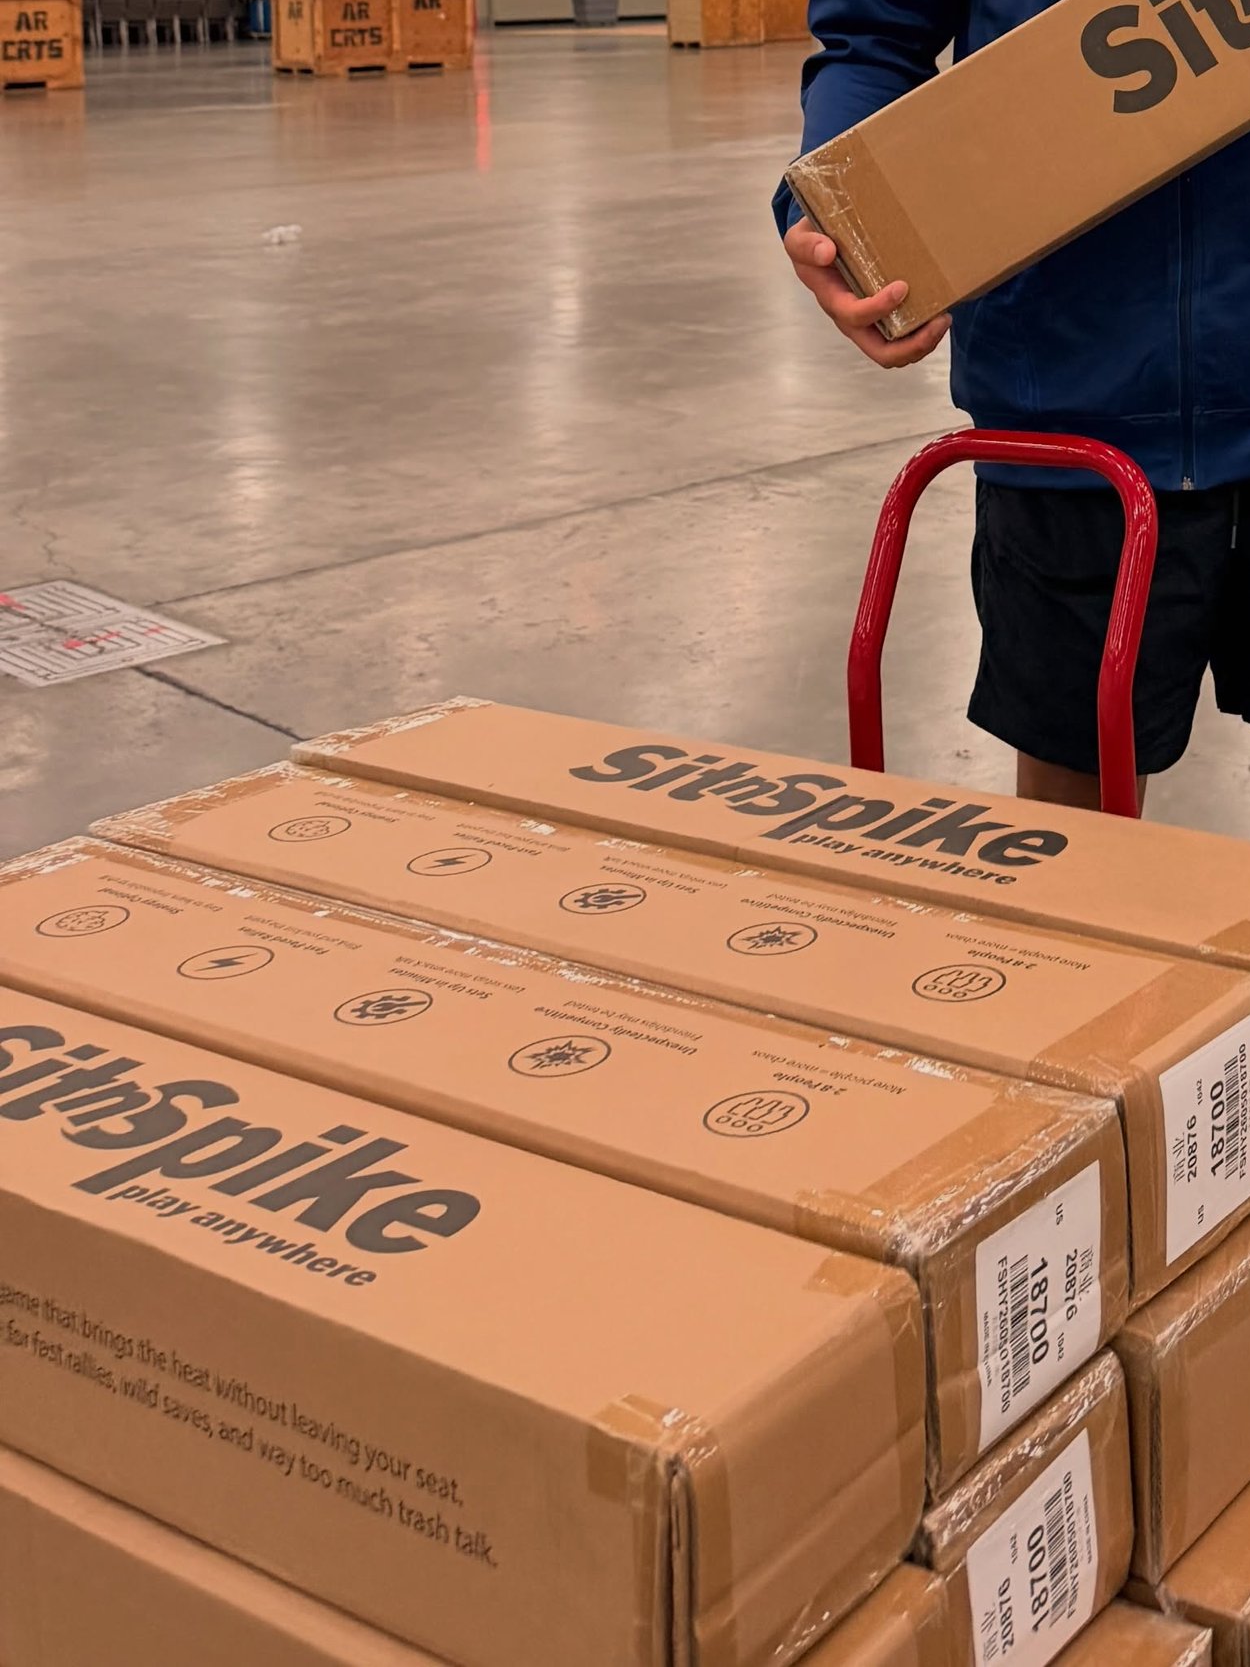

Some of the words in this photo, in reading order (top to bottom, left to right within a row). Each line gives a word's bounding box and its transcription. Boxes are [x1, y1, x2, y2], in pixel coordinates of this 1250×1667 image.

[343, 1, 370, 21] AR
[16, 11, 48, 31] AR
[330, 27, 383, 47] CRTS
[2, 39, 63, 61] CRTS
[568, 745, 1068, 867] SitnSpike
[787, 831, 861, 858] play
[862, 845, 1018, 886] anywhere
[602, 865, 643, 880] Minutes
[655, 879, 675, 887] Up
[675, 884, 700, 894] Sets
[766, 893, 801, 904] tested
[799, 899, 813, 908] be
[815, 903, 838, 912] may
[740, 898, 812, 918] Competitive
[812, 913, 896, 939] Unexpectedly
[838, 909, 897, 927] Friendships
[946, 933, 977, 943] chaos
[977, 940, 1009, 949] more
[968, 949, 1014, 963] People
[1018, 949, 1060, 962] people
[1059, 959, 1090, 970] More
[389, 968, 434, 984] Minutes
[446, 968, 471, 978] more
[448, 982, 468, 992] Up
[467, 988, 493, 999] Sets
[505, 984, 526, 993] Less
[565, 1000, 600, 1013] tested
[598, 1009, 615, 1018] be
[534, 1006, 609, 1031] Competitive
[617, 1012, 642, 1023] may
[641, 1019, 702, 1041] Friendships
[613, 1025, 697, 1055] Unexpectedly
[753, 1051, 786, 1062] chaos
[786, 1060, 822, 1072] more
[773, 1073, 823, 1091] People
[829, 1070, 876, 1085] people
[877, 1082, 906, 1095] More
[1210, 1080, 1225, 1176] 18700
[1187, 1115, 1197, 1182] 20876
[1055, 1203, 1063, 1225] US
[1197, 1205, 1204, 1224] US
[105, 1180, 202, 1219] play
[189, 1206, 377, 1287] anywhere
[1064, 1249, 1078, 1320] 20876
[1030, 1257, 1049, 1365] 18700
[0, 1283, 40, 1316] ame
[43, 1297, 79, 1333] that
[82, 1313, 133, 1359] brings
[138, 1338, 167, 1372] the
[171, 1351, 211, 1393] heat
[215, 1374, 289, 1426] without
[292, 1401, 360, 1465] leaving
[364, 1443, 411, 1483] your
[32, 1330, 63, 1367] fast
[121, 1375, 159, 1409] wild
[162, 1395, 214, 1439] saves,
[218, 1416, 255, 1453] and
[259, 1441, 299, 1479] way
[300, 1452, 333, 1490] too
[336, 1472, 394, 1519] much
[399, 1500, 449, 1544] trash
[1027, 1525, 1049, 1632] 18700
[997, 1577, 1014, 1654] 20876
